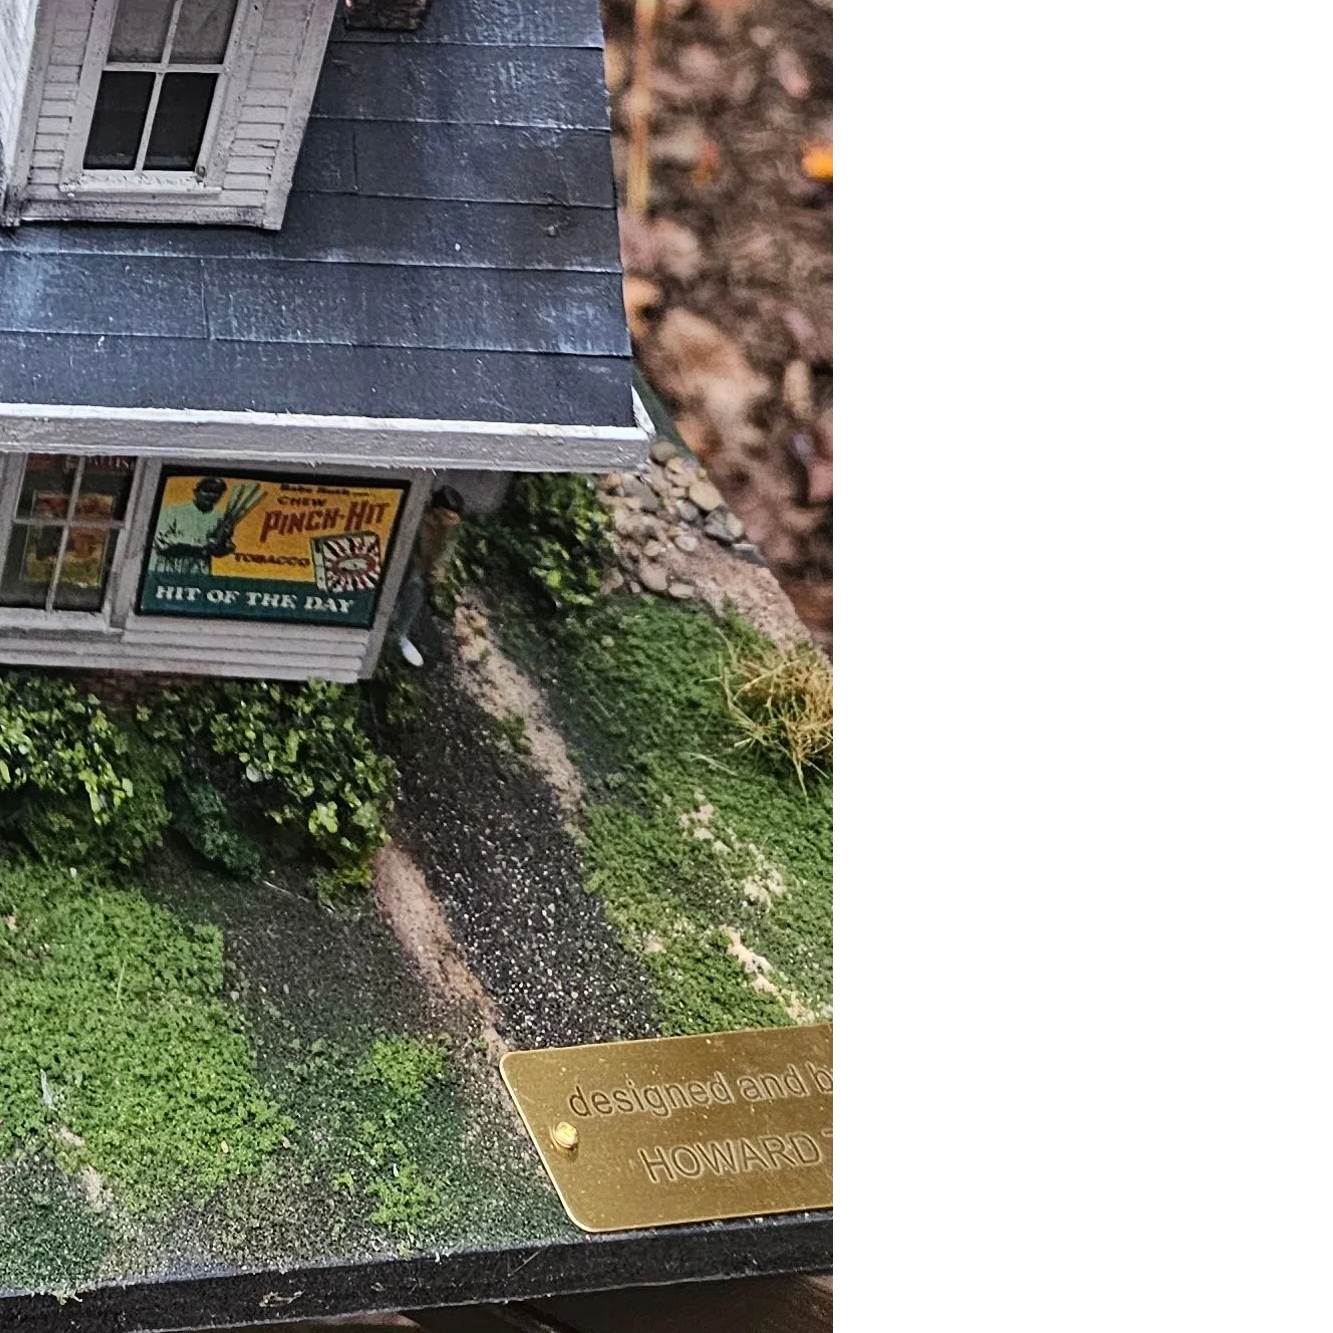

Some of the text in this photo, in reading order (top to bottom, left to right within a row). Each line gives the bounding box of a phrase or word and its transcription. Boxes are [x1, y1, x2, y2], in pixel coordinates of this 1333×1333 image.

[277, 496, 327, 507] CHEW
[235, 553, 310, 567] TOBACCO
[155, 585, 355, 614] HIT OF THE DAY
[568, 1071, 732, 1118] designed
[737, 1063, 810, 1098] and
[637, 1131, 822, 1183] HOWARD
